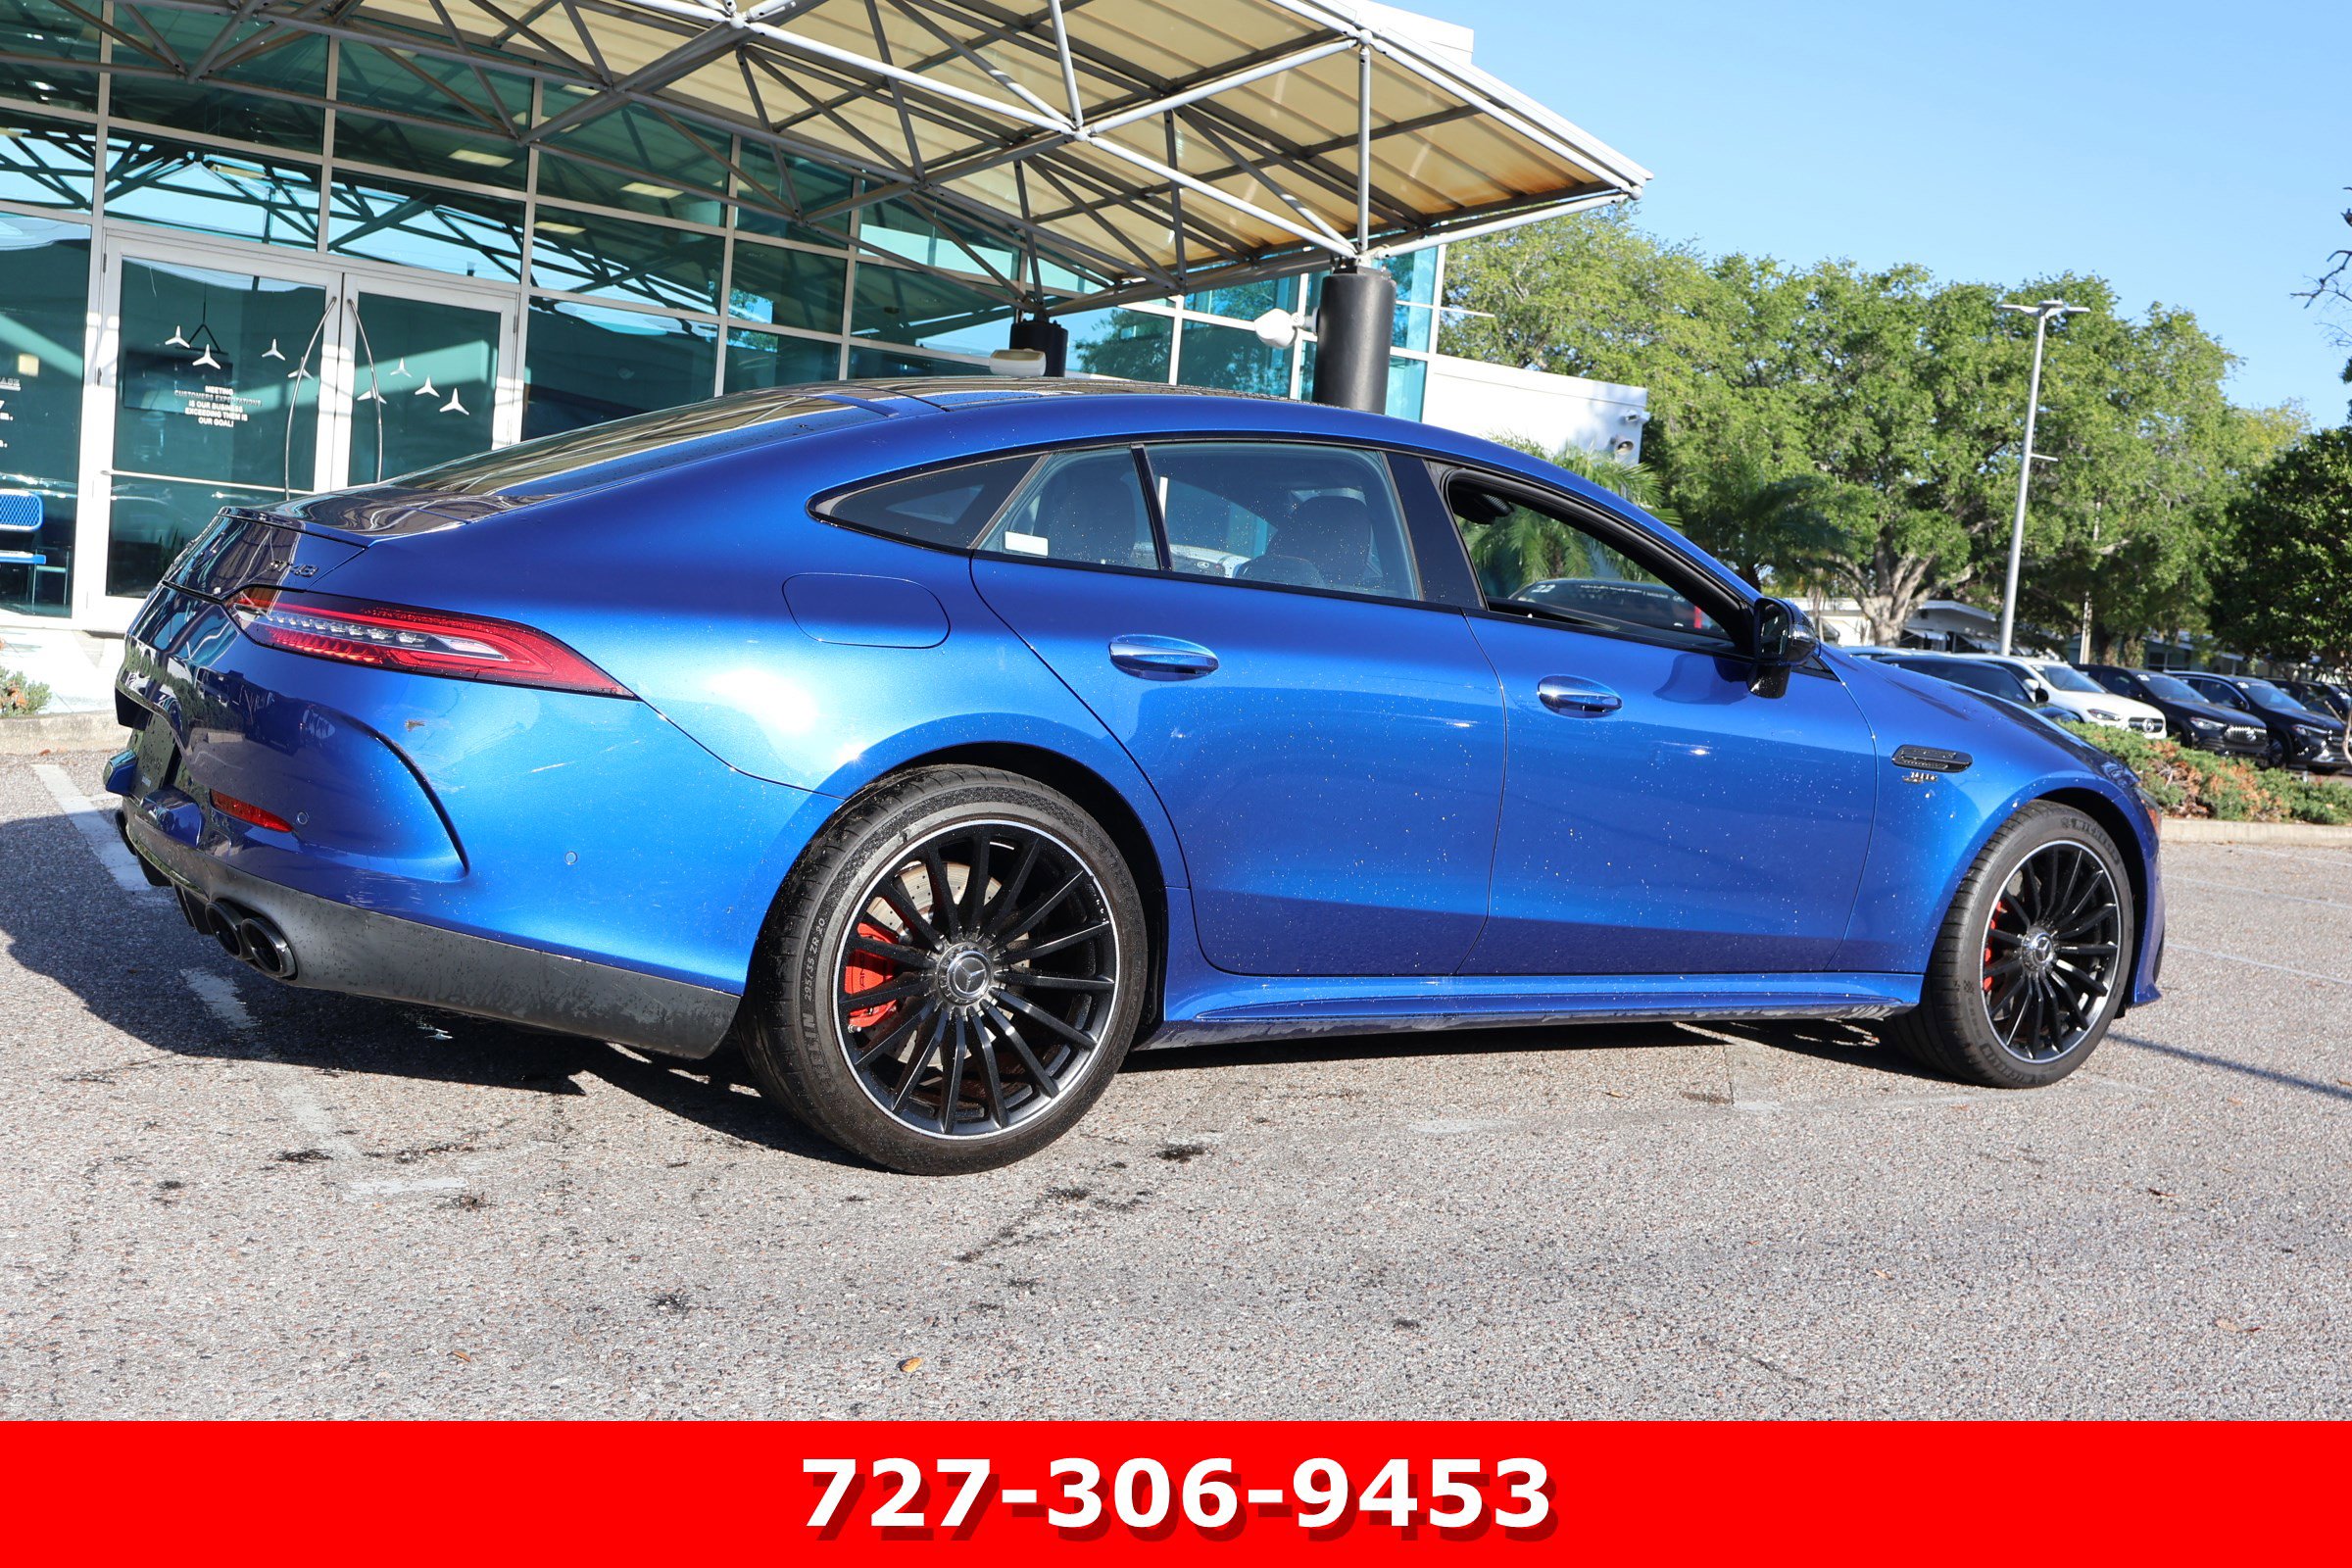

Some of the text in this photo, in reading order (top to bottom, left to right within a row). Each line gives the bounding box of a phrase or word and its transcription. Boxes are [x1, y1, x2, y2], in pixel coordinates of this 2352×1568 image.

[174, 389, 214, 401] CUSTOMERS
[205, 385, 234, 396] MEETING
[188, 399, 244, 414] IS OUR BUSINESS
[184, 407, 248, 422] EXCEEDING THEM IS
[198, 416, 214, 425] OUR
[816, 917, 825, 938] 20
[809, 937, 819, 955] ZR
[804, 956, 815, 1002] 295/35
